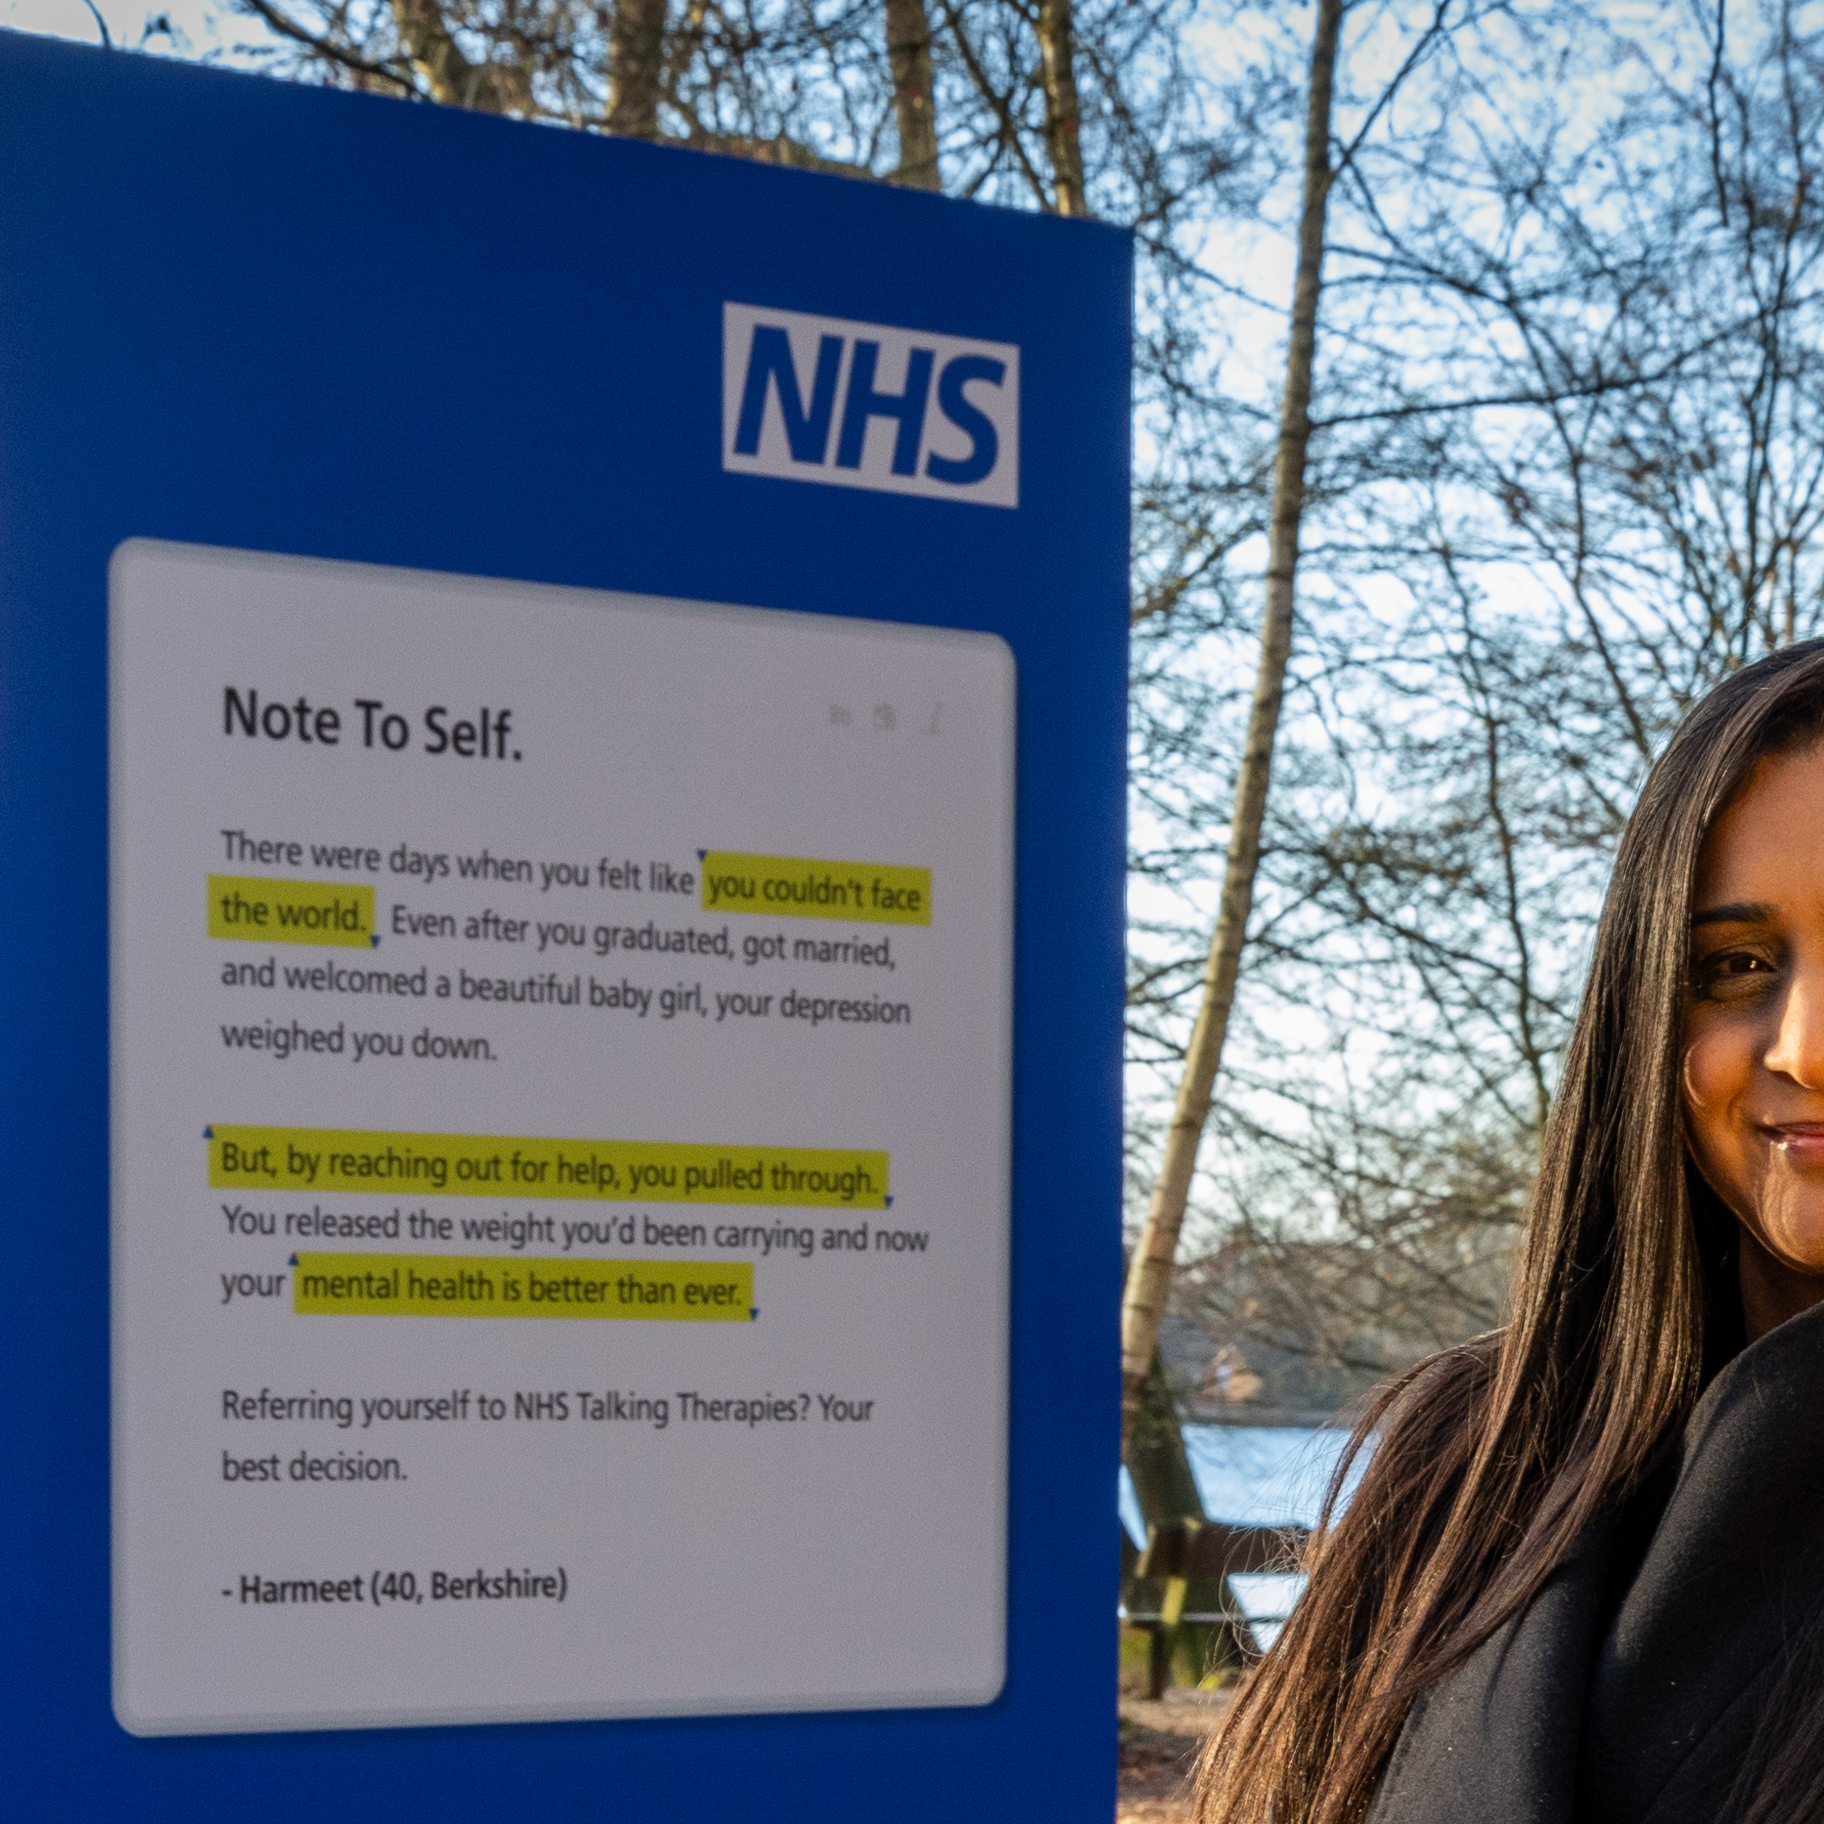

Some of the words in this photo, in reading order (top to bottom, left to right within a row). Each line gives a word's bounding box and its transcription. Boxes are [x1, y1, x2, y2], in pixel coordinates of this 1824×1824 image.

[733, 325, 1006, 487] NHS
[223, 685, 341, 747] Note
[353, 697, 411, 753] To
[423, 704, 522, 762] Self.
[219, 827, 303, 868] There
[311, 844, 381, 875] were
[388, 841, 450, 886] days
[458, 847, 533, 884] when
[539, 861, 591, 894] you
[596, 855, 643, 893] felt
[648, 860, 696, 898] like
[708, 874, 757, 906] you
[870, 876, 922, 914] face
[219, 890, 270, 928] the
[277, 897, 367, 934] world.
[390, 902, 457, 939] Even
[464, 907, 528, 945] after
[535, 921, 587, 954] you
[593, 919, 735, 962] graduated,
[741, 932, 787, 969] got
[793, 933, 896, 973] married,
[220, 954, 277, 990] and
[284, 958, 428, 999] welcomed
[434, 973, 452, 1000] a
[458, 966, 582, 1007] beautiful
[588, 975, 652, 1019] baby
[658, 981, 709, 1022] girl,
[715, 992, 773, 1024] your
[780, 987, 911, 1028] depression
[221, 1017, 346, 1062] weighed
[351, 1030, 405, 1065] you
[411, 1025, 497, 1061] down.
[220, 1139, 278, 1180] But,
[286, 1141, 322, 1186] by
[328, 1145, 449, 1190] reaching
[454, 1153, 504, 1183] out
[509, 1149, 550, 1185] for
[556, 1152, 621, 1194] help,
[627, 1163, 678, 1196] you
[683, 1158, 765, 1197] pulled
[770, 1161, 880, 1204] through.
[220, 1202, 277, 1238] You
[284, 1204, 401, 1240] released
[406, 1207, 455, 1243] the
[462, 1210, 555, 1252] weight
[642, 1213, 707, 1248] been
[712, 1218, 815, 1260] carrying
[820, 1220, 869, 1253] and
[874, 1229, 930, 1254] now
[220, 1272, 287, 1307] your
[302, 1266, 400, 1301] mental
[407, 1267, 494, 1303] health
[502, 1270, 523, 1304] is
[527, 1269, 608, 1305] better
[616, 1272, 676, 1306] than
[682, 1281, 742, 1307] ever.
[221, 1385, 354, 1431] Referring
[360, 1387, 471, 1431] yourself
[476, 1393, 508, 1423] to
[513, 1389, 570, 1423] NHS
[575, 1389, 670, 1431] Talking
[675, 1389, 812, 1430] Therapies?
[816, 1393, 875, 1424] Your
[221, 1449, 281, 1484] best
[287, 1448, 408, 1483] decision.
[239, 1573, 364, 1606] Harmeet
[369, 1568, 424, 1608] (40,
[430, 1565, 567, 1604] Berkshire)
